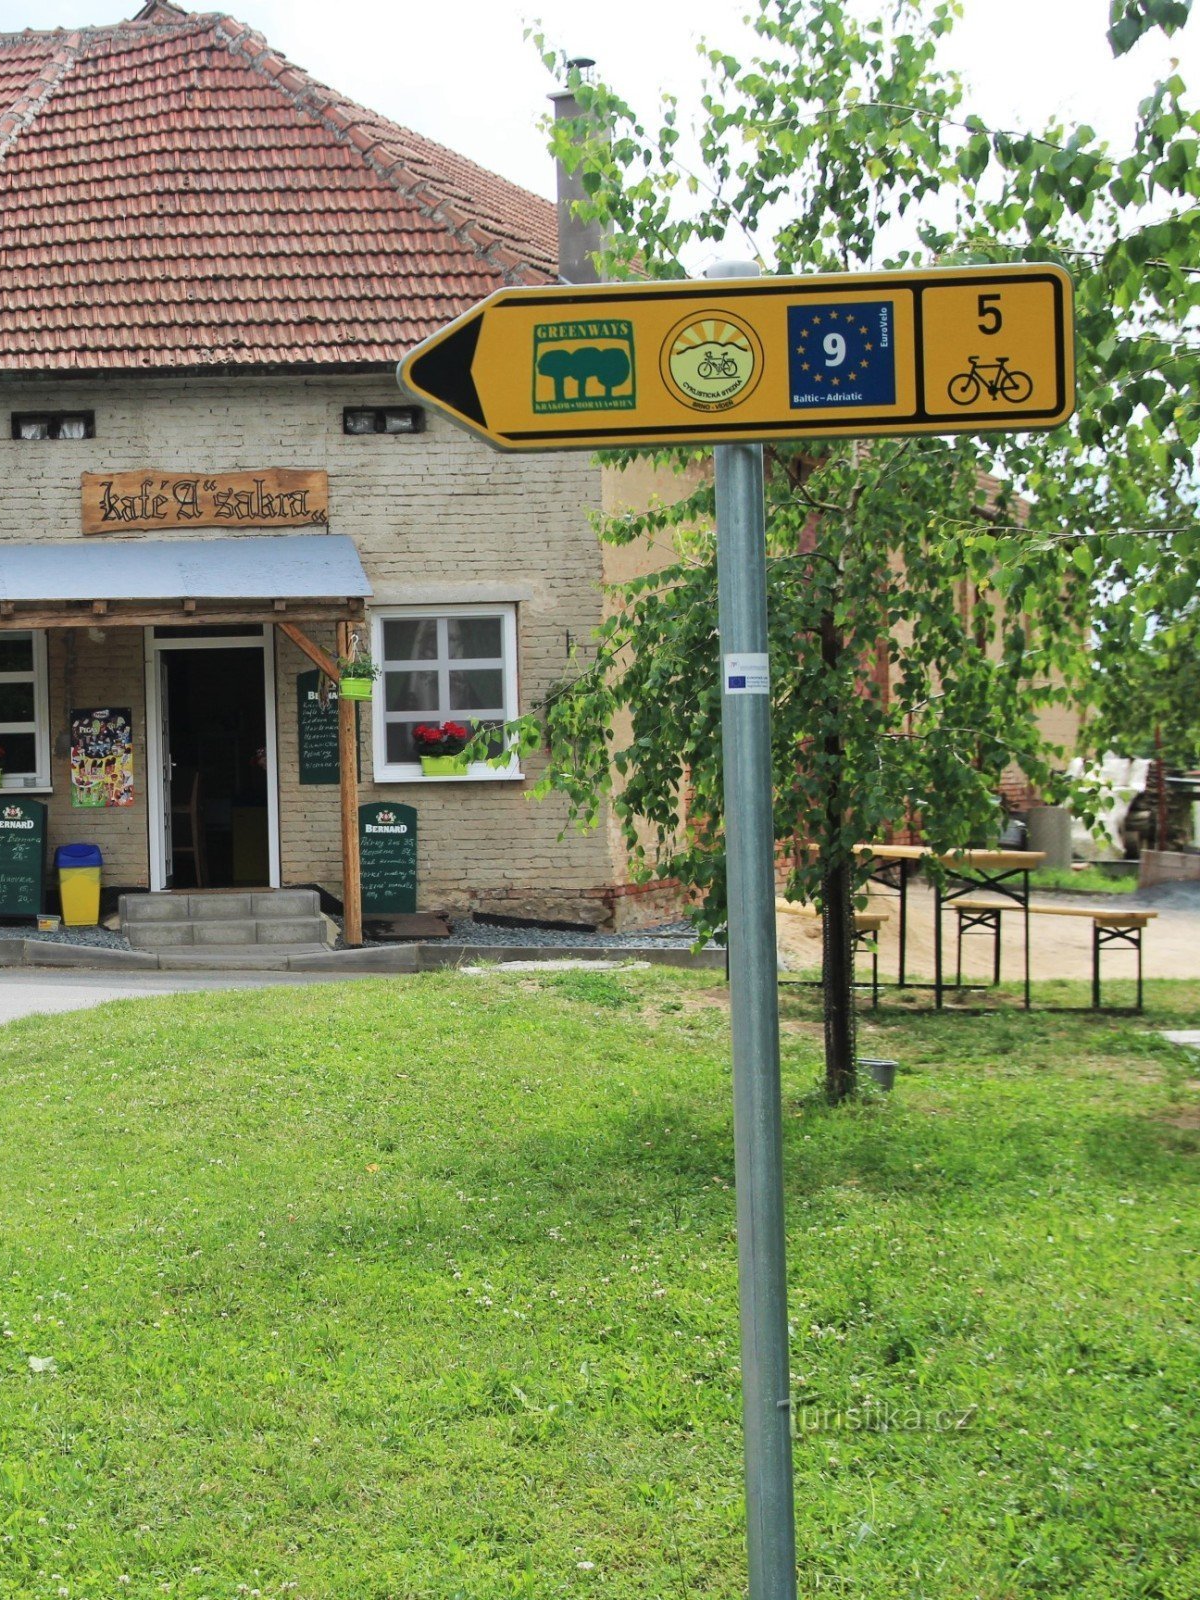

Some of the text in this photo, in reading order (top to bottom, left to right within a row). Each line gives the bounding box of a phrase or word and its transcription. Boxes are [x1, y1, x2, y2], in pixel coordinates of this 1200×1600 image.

[880, 307, 888, 348] EuroVelo
[978, 293, 1003, 335] 5
[536, 322, 629, 338] GREENWAYS
[822, 332, 847, 367] 9
[682, 379, 743, 398] CYKLISTICKÁ STEZKA
[692, 401, 711, 410] BRNO
